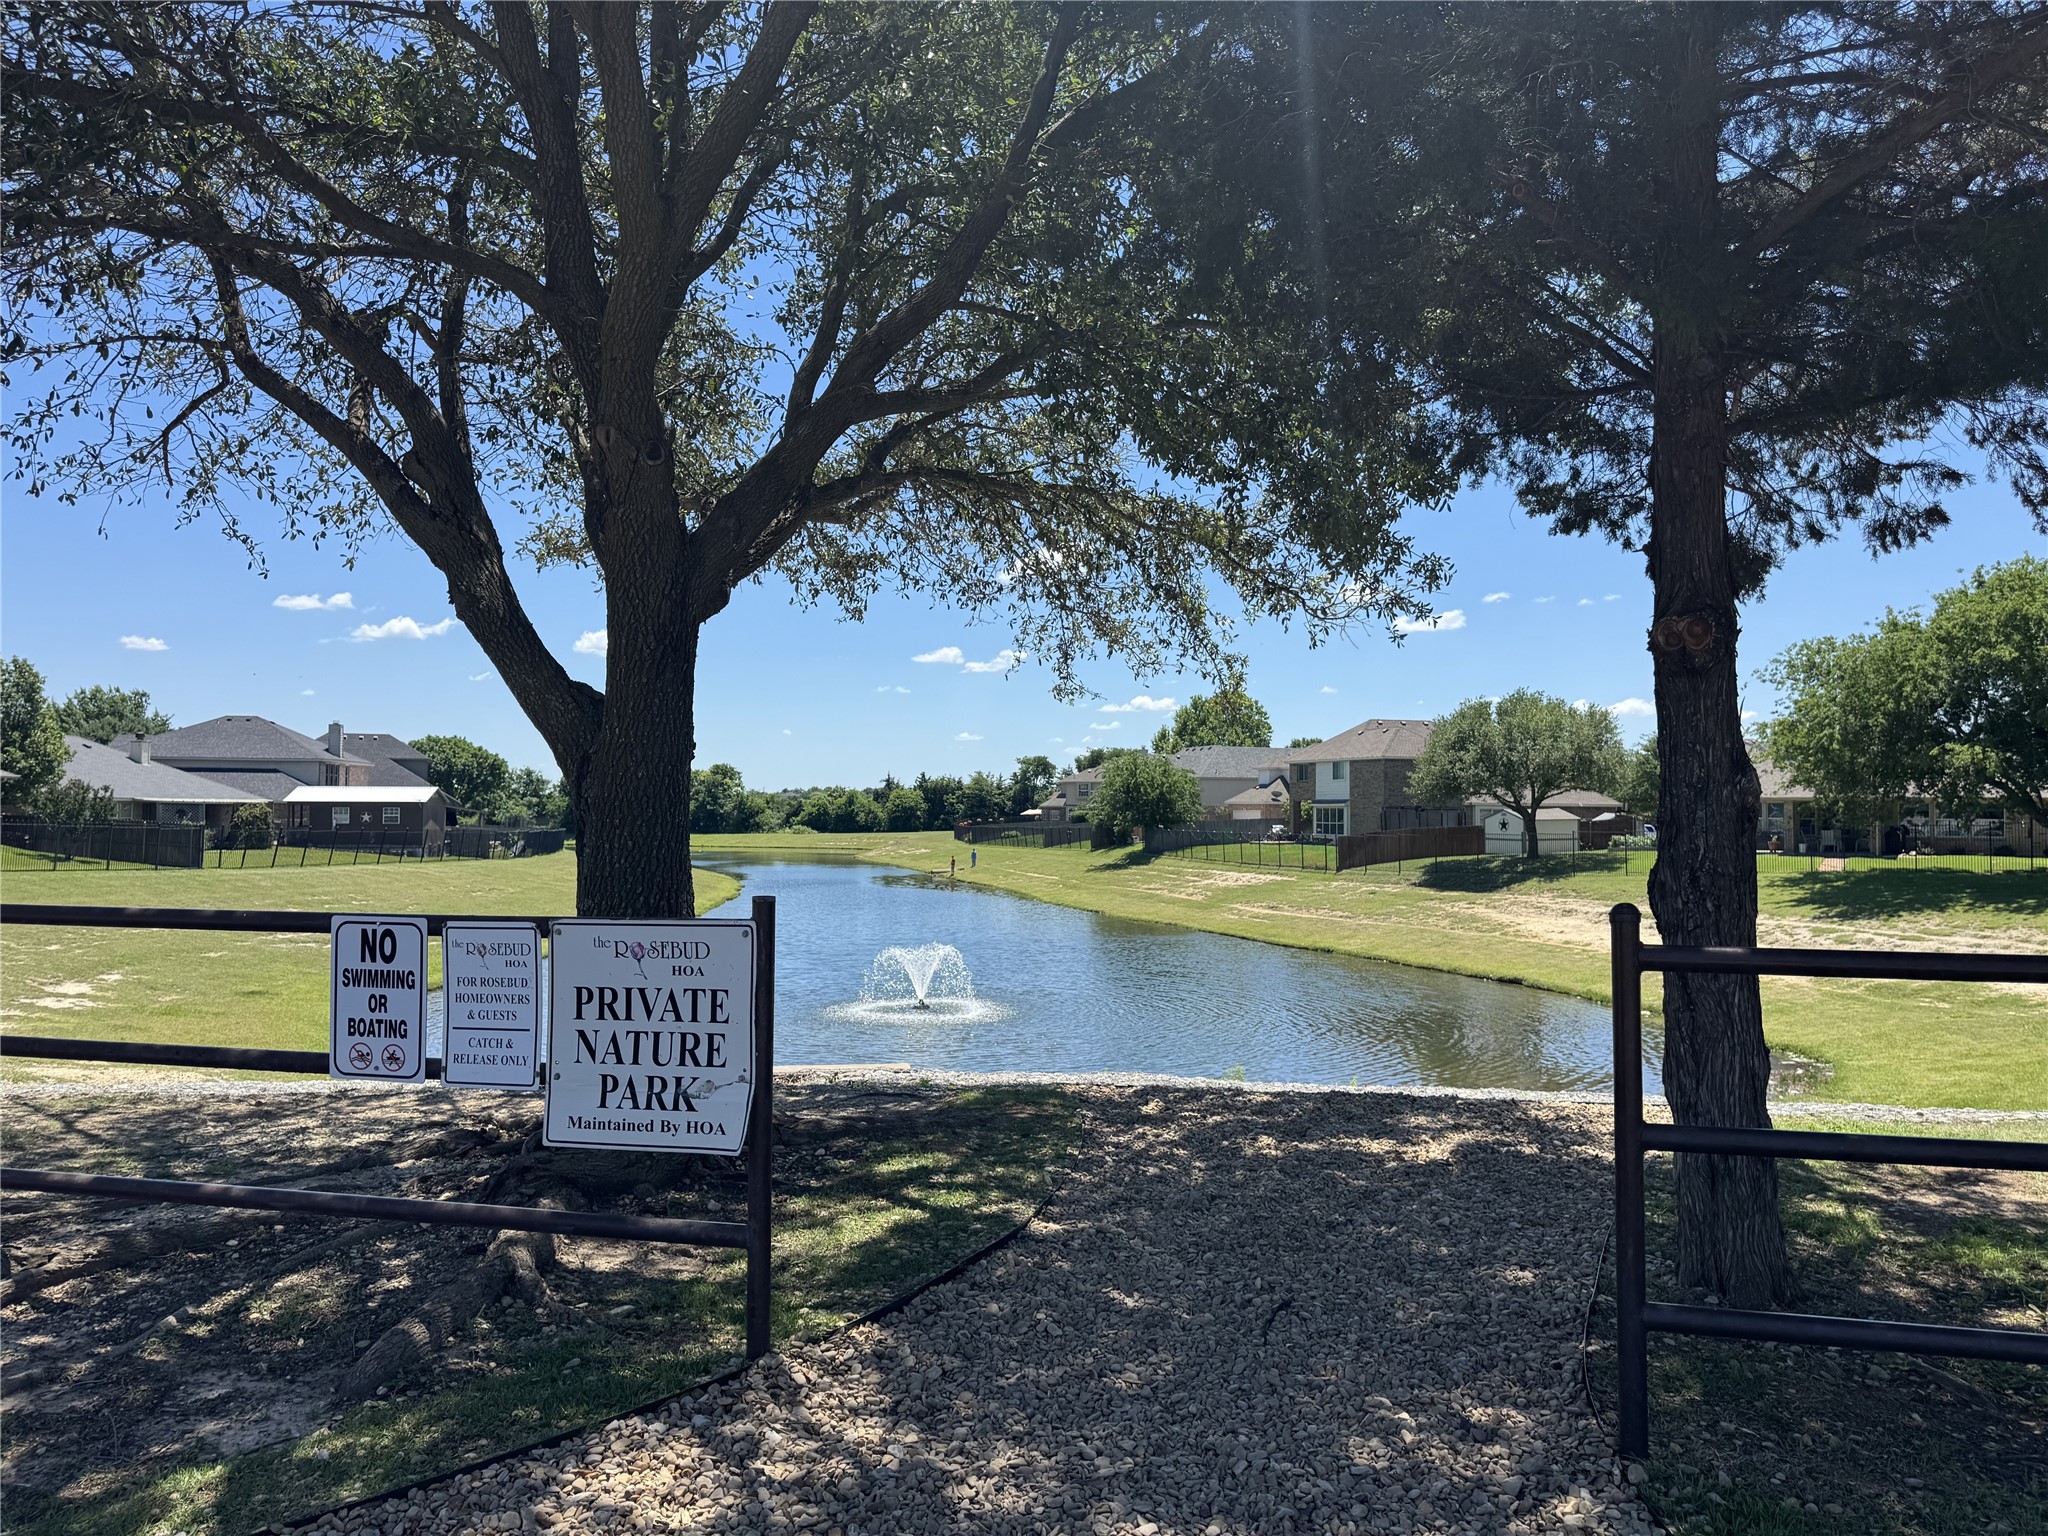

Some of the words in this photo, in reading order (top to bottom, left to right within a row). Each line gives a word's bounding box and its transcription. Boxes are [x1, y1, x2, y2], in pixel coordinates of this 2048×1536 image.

[360, 928, 397, 964] NO
[451, 939, 464, 949] the
[593, 936, 612, 949] the
[505, 959, 528, 968] HOA
[671, 965, 705, 977] HOA
[342, 967, 416, 990] SWIMMING
[456, 976, 478, 987] FOR
[480, 977, 528, 988] ROSEBUD
[367, 993, 388, 1014] OR
[455, 992, 531, 1005] HOMEOWNERS
[572, 986, 730, 1025] PRIVATE
[467, 1009, 475, 1020] &
[478, 1009, 517, 1021] GUESTS
[347, 1017, 408, 1040] BOATING
[468, 1037, 503, 1049] CATCH
[505, 1038, 514, 1050] &
[573, 1028, 728, 1069] NATURE
[452, 1053, 499, 1065] RELEASE
[500, 1055, 530, 1067] ONLY
[596, 1073, 701, 1113] PARK
[567, 1115, 654, 1133] Maintained
[660, 1119, 681, 1137] By
[686, 1120, 727, 1136] HOA
